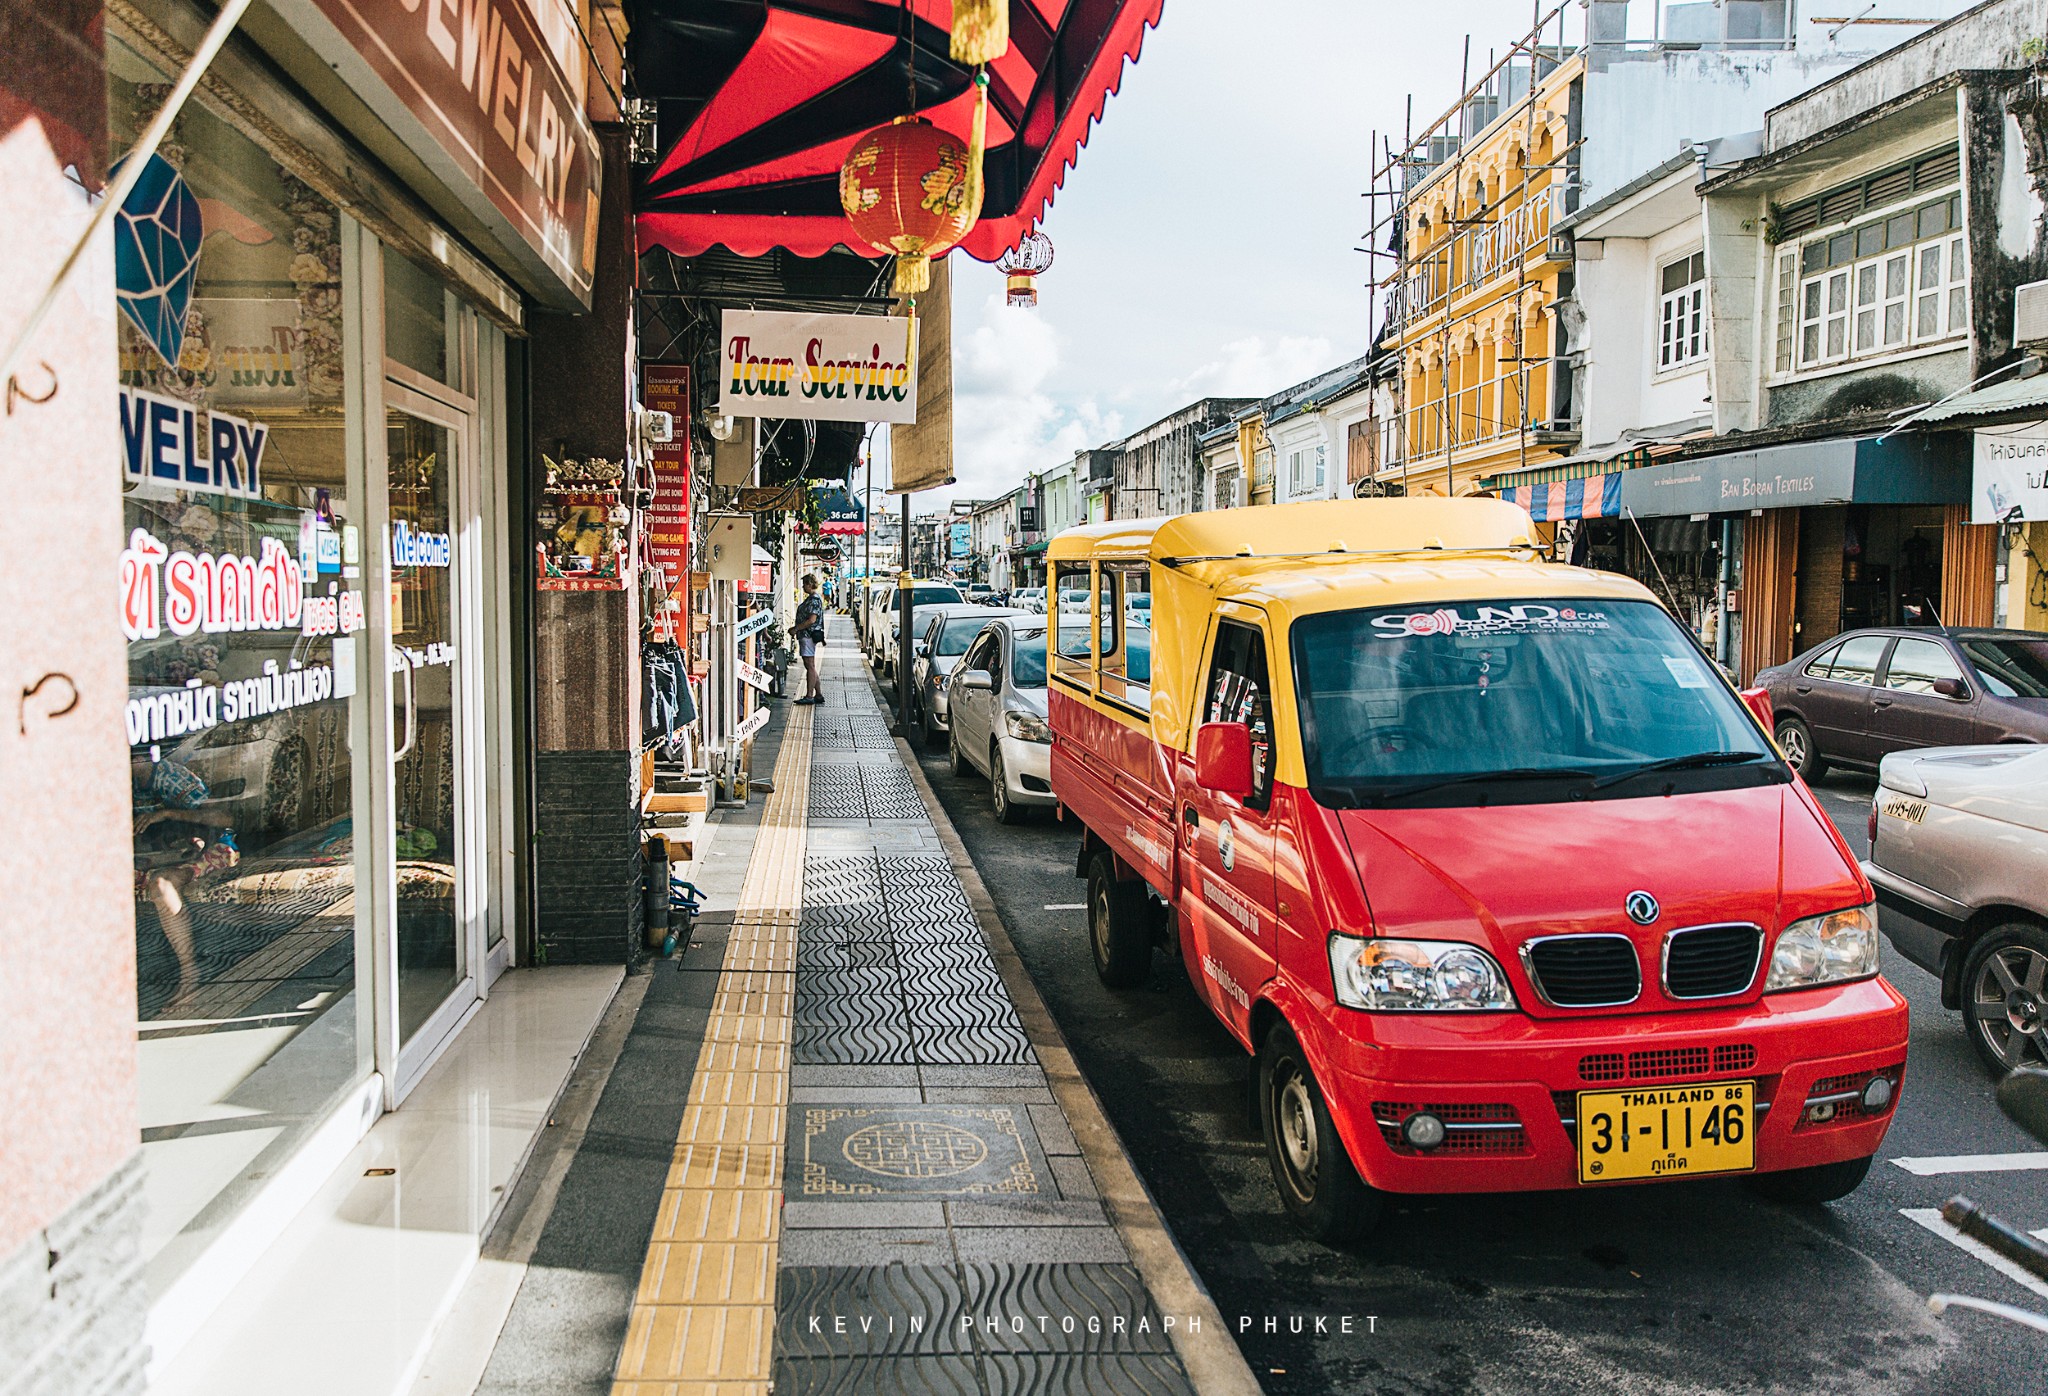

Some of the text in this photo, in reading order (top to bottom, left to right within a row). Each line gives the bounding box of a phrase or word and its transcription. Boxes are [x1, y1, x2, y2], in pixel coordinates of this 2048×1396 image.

[728, 336, 908, 402] Tour Service
[648, 385, 671, 394] BOOKING
[657, 401, 677, 410] TICKETS
[664, 443, 682, 452] TICKET
[655, 461, 679, 470] DAY TOUR
[393, 521, 449, 565] Welcome
[669, 533, 684, 542] GAME
[320, 538, 339, 557] VISA
[670, 547, 681, 556] FOX
[169, 542, 302, 628] ราคาส่ง
[1621, 1087, 1743, 1106] THAILAND 86
[1591, 1103, 1744, 1154] 31-1146
[1651, 1152, 1687, 1174] ภูเก็ต
